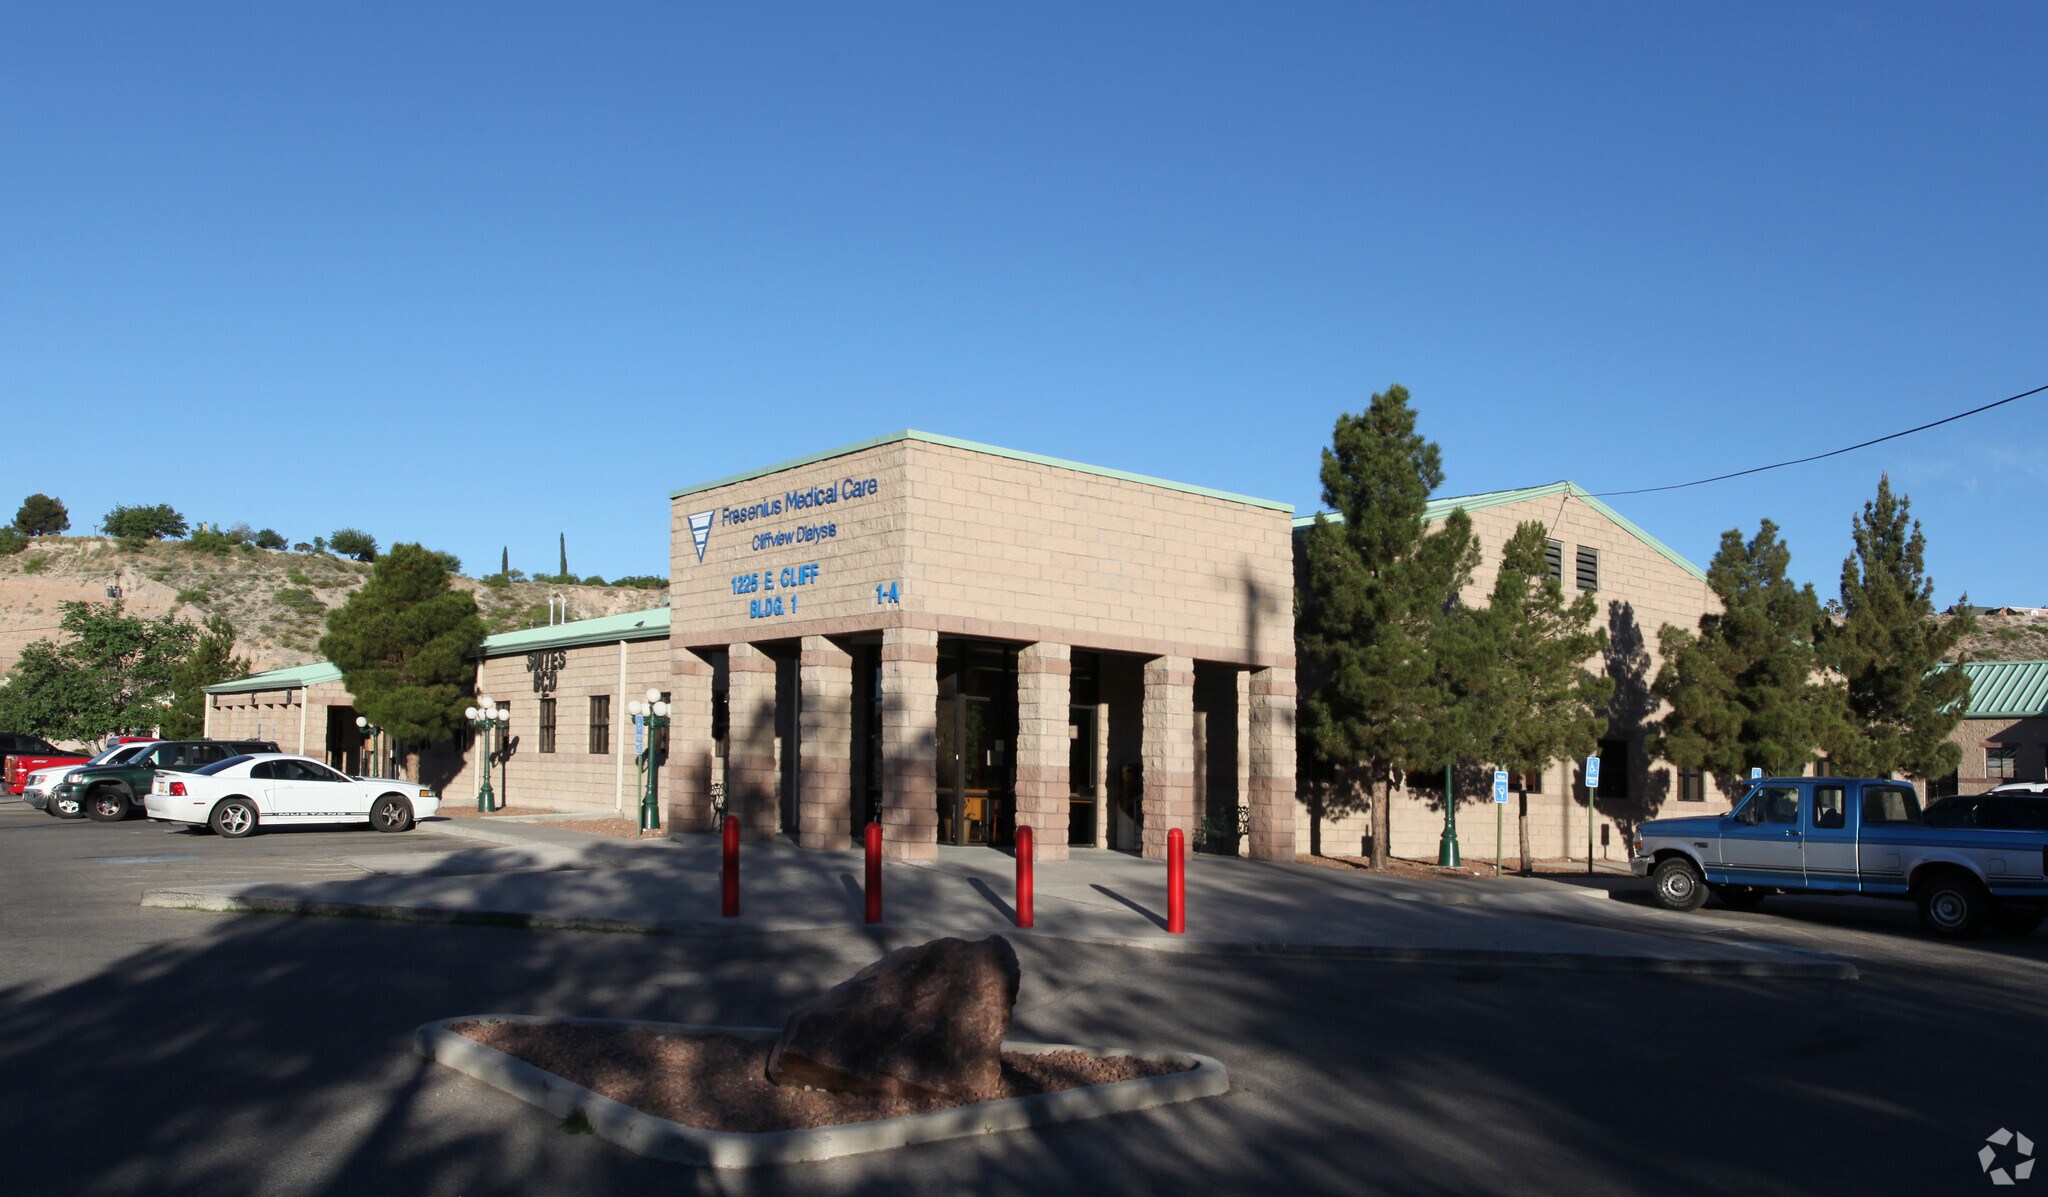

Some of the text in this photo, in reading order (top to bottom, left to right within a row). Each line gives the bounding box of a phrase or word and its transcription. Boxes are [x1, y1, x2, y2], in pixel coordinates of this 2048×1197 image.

[722, 478, 878, 527] Fresenius Medical Care
[752, 520, 837, 551] Cliffview Dialysis
[731, 572, 760, 595] 1225
[780, 563, 820, 588] CLIFF
[791, 594, 798, 613] 1
[876, 581, 900, 605] 1-A
[526, 649, 567, 672] SUITES
